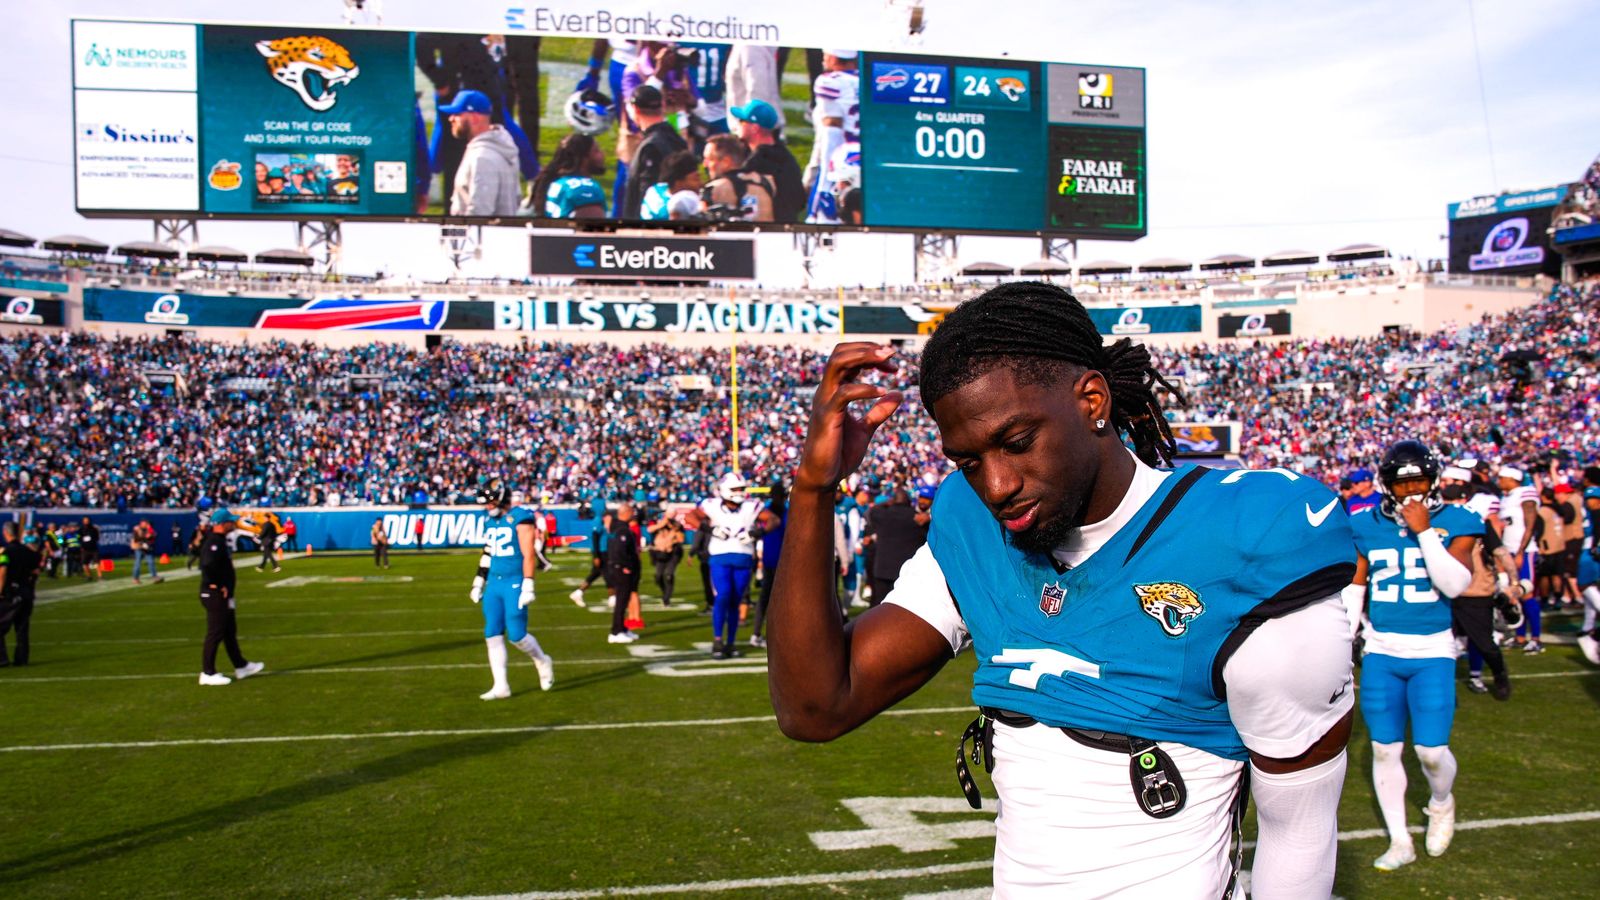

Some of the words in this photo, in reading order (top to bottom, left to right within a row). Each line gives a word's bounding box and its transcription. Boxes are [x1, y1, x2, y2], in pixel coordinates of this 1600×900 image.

[535, 8, 661, 34] EverBank
[670, 14, 779, 41] Stadium
[116, 48, 187, 60] NEMOURS
[913, 72, 942, 94] 27
[963, 75, 992, 97] 24
[1080, 95, 1112, 109] PRI
[263, 120, 290, 131] SCAN
[291, 121, 309, 131] THE
[311, 121, 325, 131] QR
[326, 121, 352, 132] CODE
[935, 111, 986, 125] QUARTER
[243, 133, 265, 143] AND
[266, 134, 302, 144] SUBMIT
[304, 134, 330, 144] YOUR
[915, 126, 986, 160] 0:00
[1062, 158, 1123, 178] FARAH
[600, 244, 715, 271] EverBank
[494, 299, 605, 330] BILLS
[665, 301, 841, 334] JAGUARS
[485, 526, 515, 557] 92
[1367, 547, 1440, 603] 25
[1041, 595, 1060, 613] NFL
